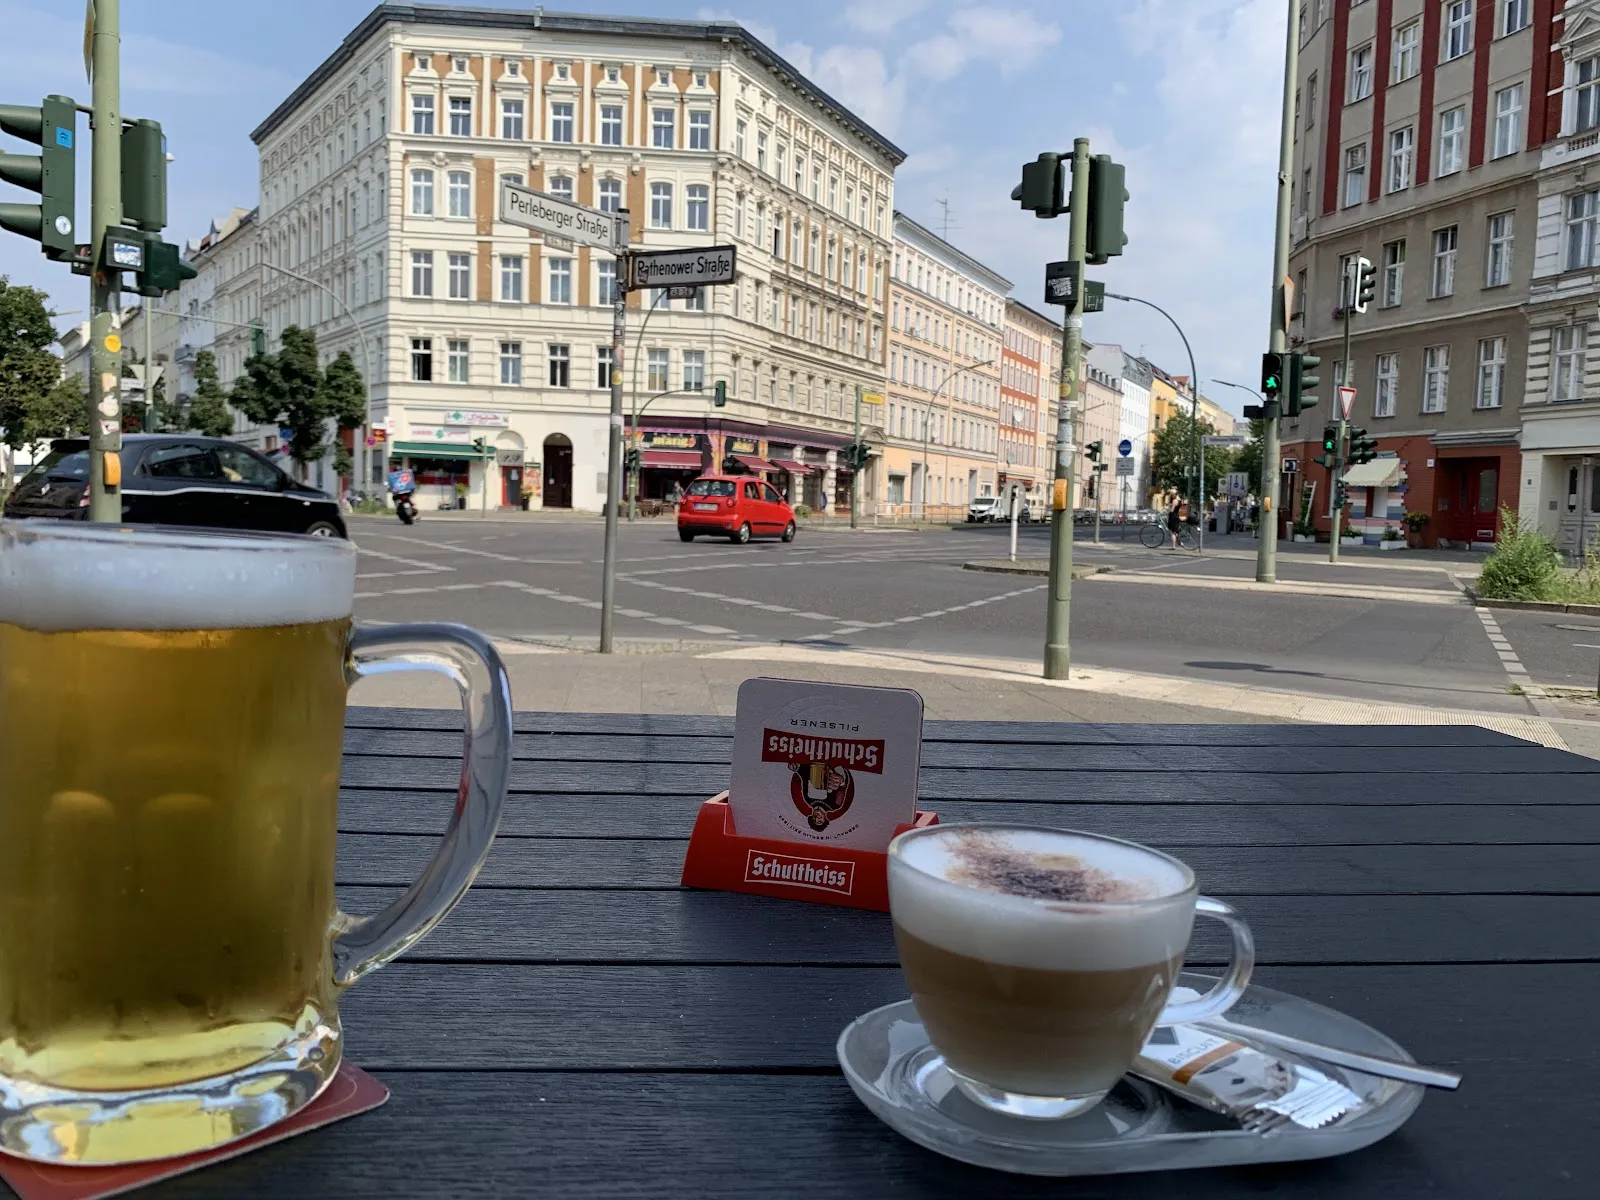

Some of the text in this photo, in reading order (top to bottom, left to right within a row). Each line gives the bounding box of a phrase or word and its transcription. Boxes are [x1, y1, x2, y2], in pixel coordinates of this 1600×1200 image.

[511, 192, 608, 240] Perleberger Straße
[637, 255, 730, 278] Rathenower Straße
[790, 718, 859, 732] PILSENER
[768, 735, 879, 767] Schultheiss
[751, 856, 847, 887] Schultheiss
[1167, 1037, 1219, 1065] BISCUIT
